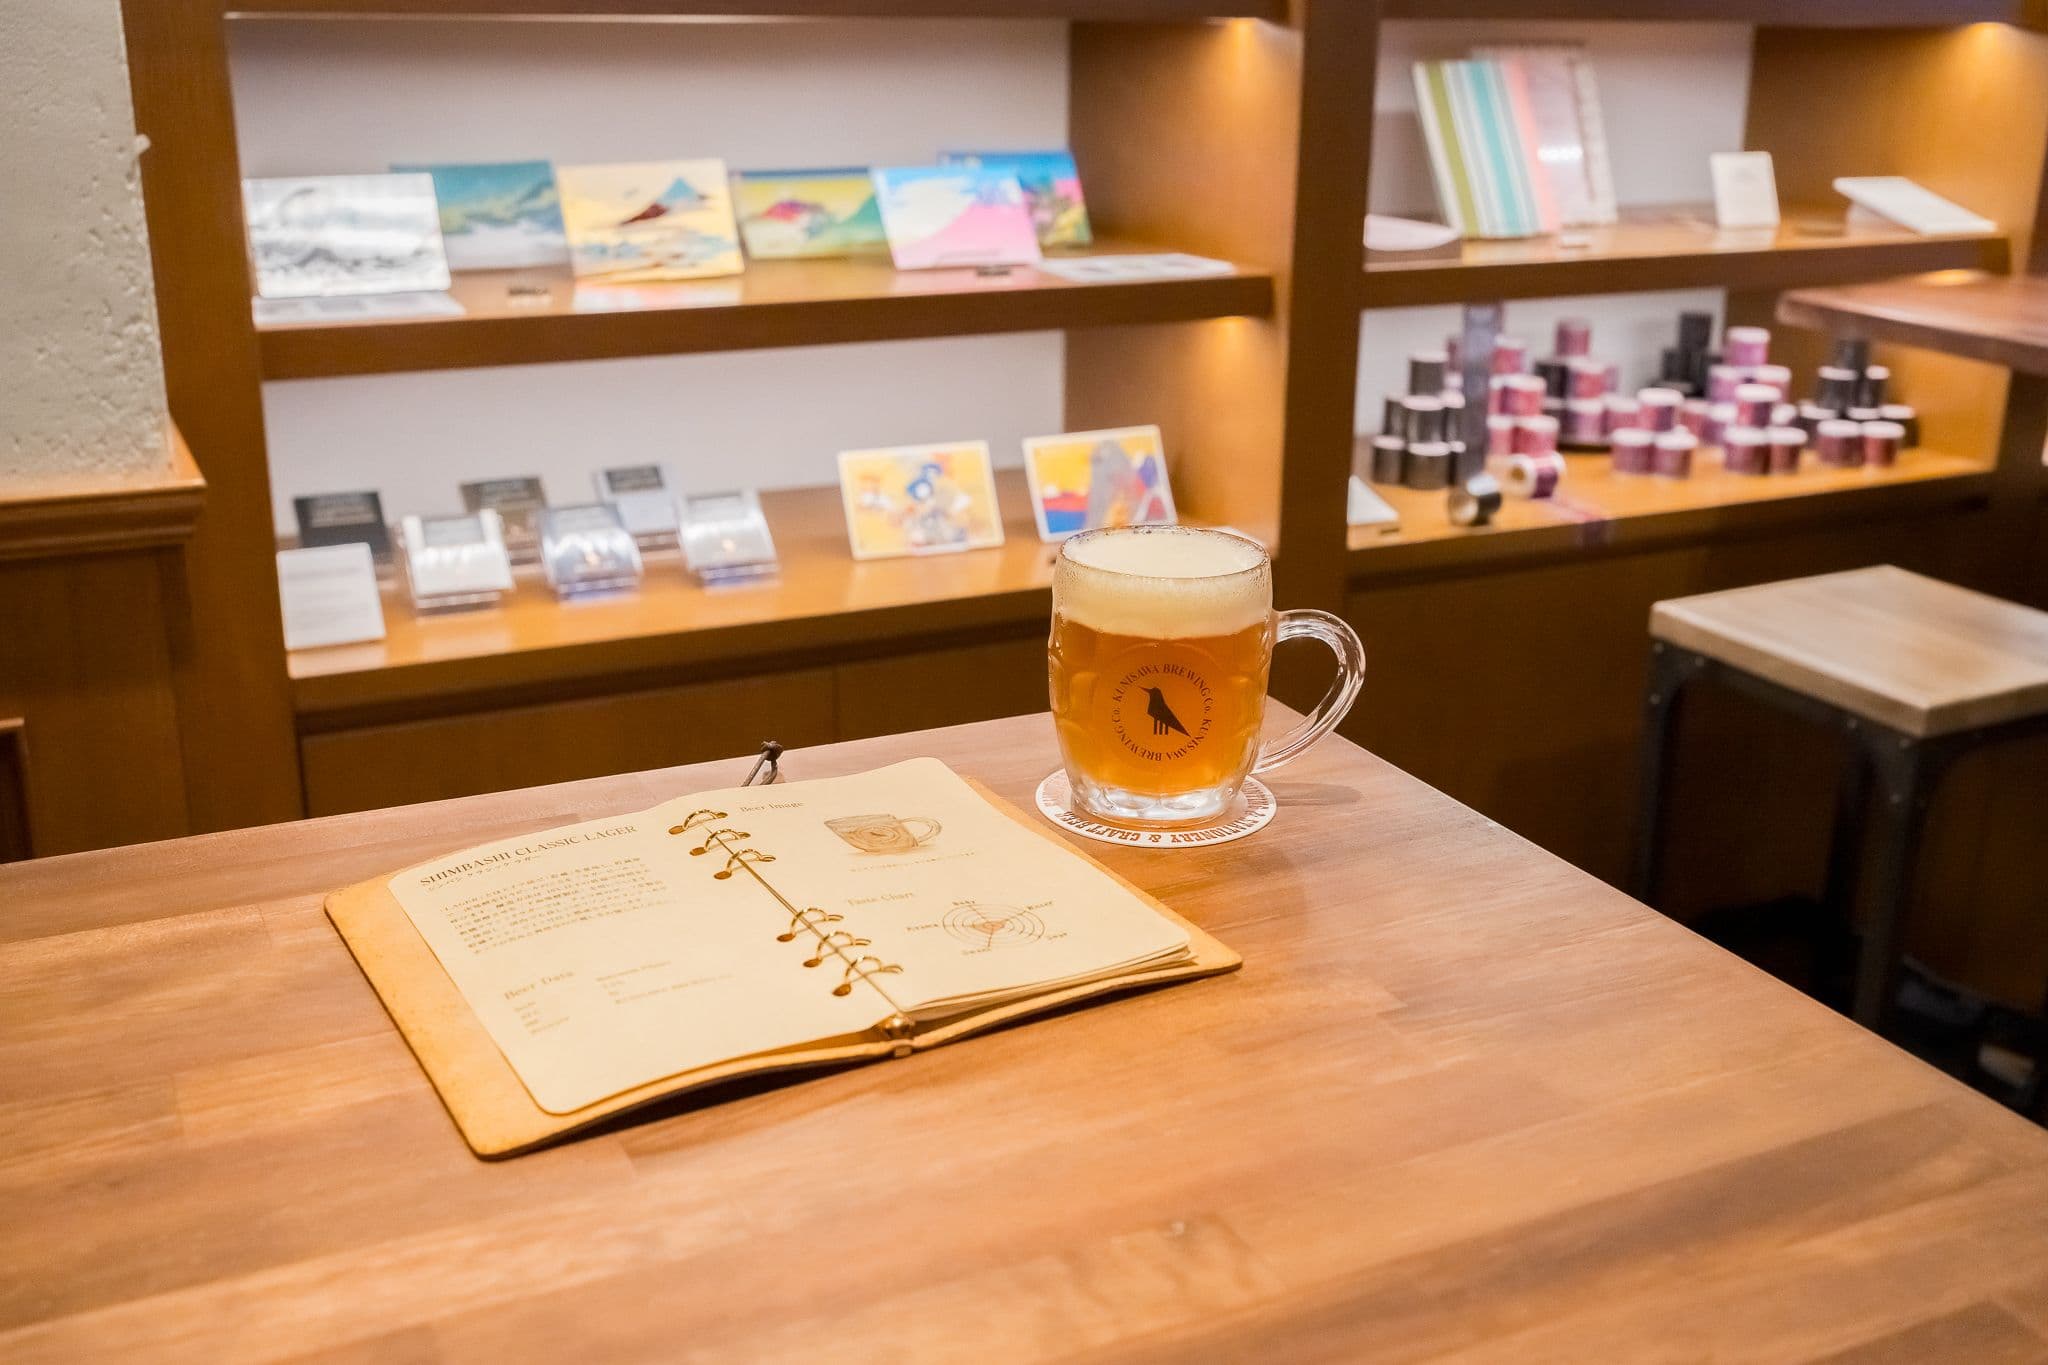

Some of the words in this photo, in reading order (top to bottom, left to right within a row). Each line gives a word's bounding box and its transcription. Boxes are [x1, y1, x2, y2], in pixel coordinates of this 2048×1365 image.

[1113, 664, 1160, 702] KUNISAWA
[1163, 664, 1211, 697] BREWING
[1114, 725, 1162, 761] BREWING
[1165, 718, 1212, 760] KUNISAWA
[1086, 823, 1142, 842] CRAFT
[1149, 833, 1162, 844] &
[1171, 816, 1259, 843] STATIONERY
[420, 851, 511, 886] SHIMBASHI
[514, 836, 581, 857] CLASSIC
[583, 825, 638, 841] LAGER
